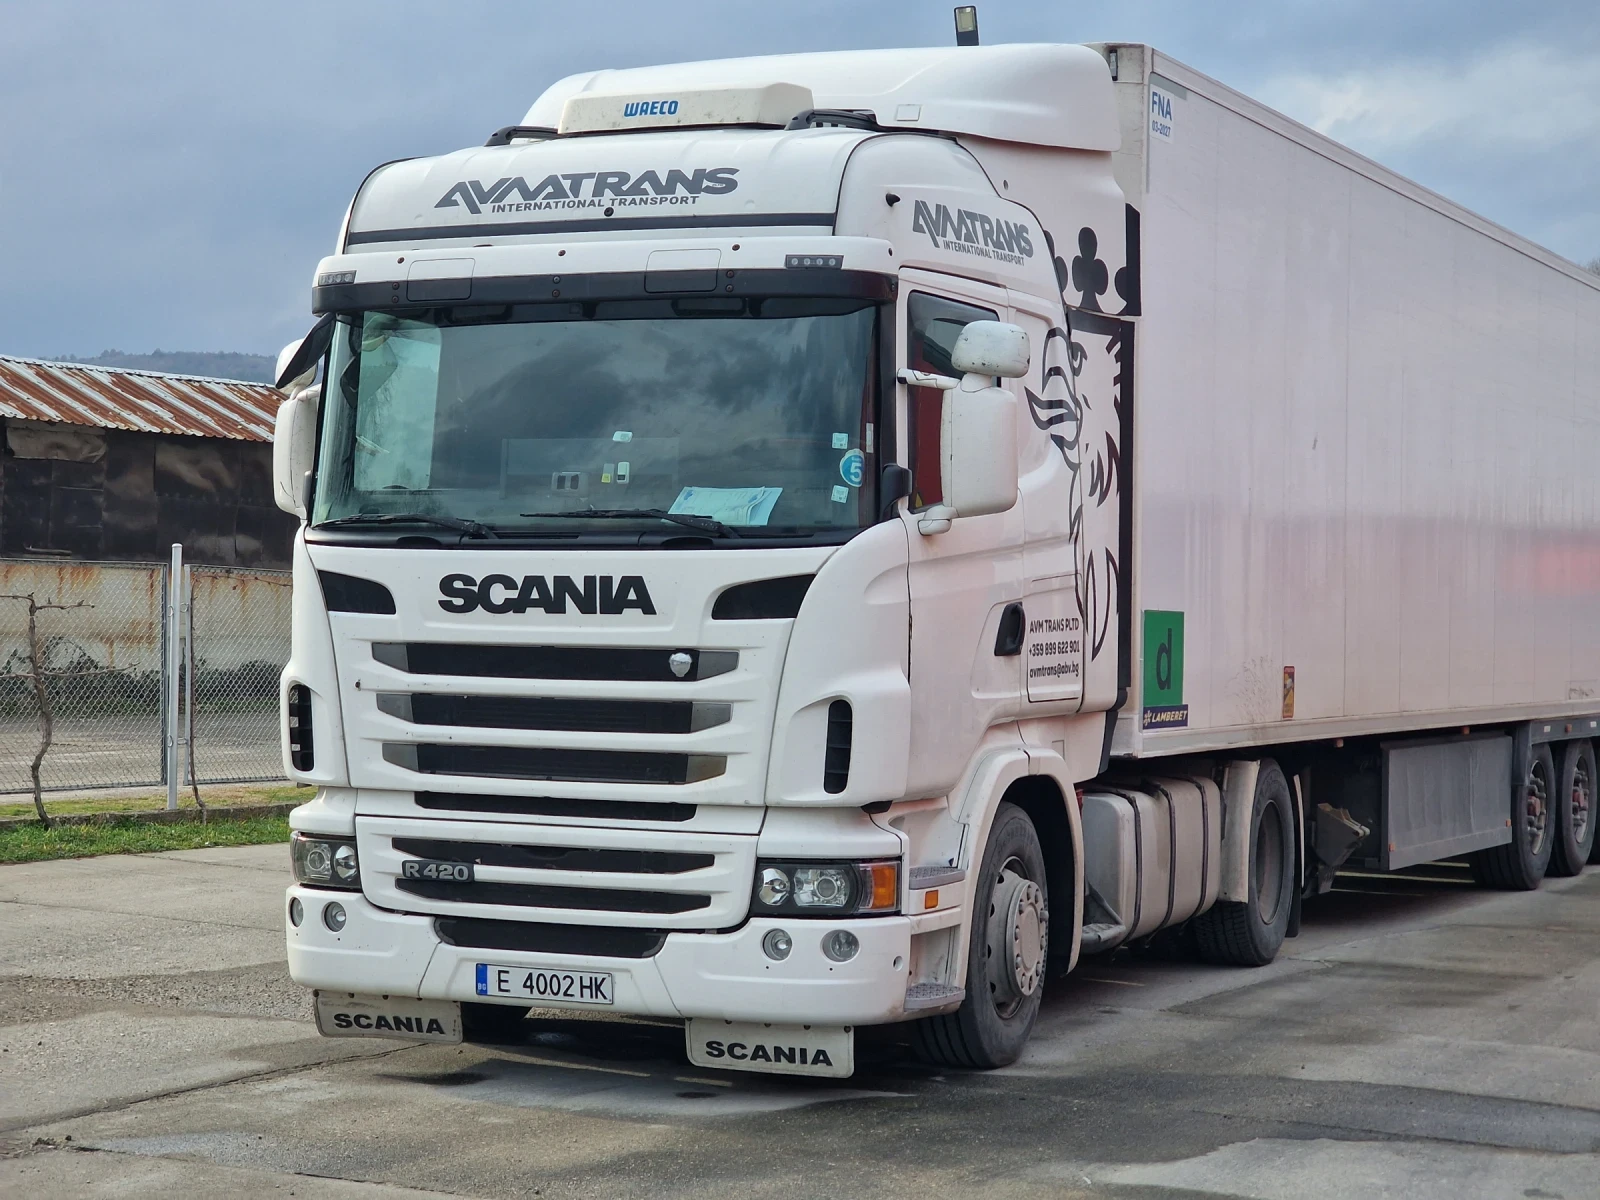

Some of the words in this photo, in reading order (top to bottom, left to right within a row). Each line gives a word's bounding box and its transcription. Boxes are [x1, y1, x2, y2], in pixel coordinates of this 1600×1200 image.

[624, 101, 679, 117] WAECO
[1152, 91, 1172, 121] FNA
[491, 198, 605, 213] INTERNATIONAL
[610, 195, 700, 208] TRANSPORT
[943, 239, 992, 259] INTERNATIONAL
[992, 249, 1025, 266] TRANSPORT
[849, 462, 863, 482] 5
[438, 573, 657, 615] SCANIA
[1029, 620, 1044, 634] AVM
[1044, 618, 1065, 633] TRANS
[1065, 617, 1080, 631] PLTD
[1029, 643, 1044, 657] +359
[1045, 641, 1057, 656] 899
[1057, 640, 1069, 655] 622
[1069, 639, 1080, 653] 901
[1156, 628, 1172, 690] d
[1029, 661, 1080, 678] avmtrans@abv.bg
[1151, 710, 1188, 723] LAMBERET
[405, 862, 420, 878] R
[423, 863, 469, 881] 420
[477, 982, 487, 991] BG
[497, 969, 511, 993] E
[333, 1013, 446, 1035] SCANIA
[705, 1040, 833, 1067] SCANIA
